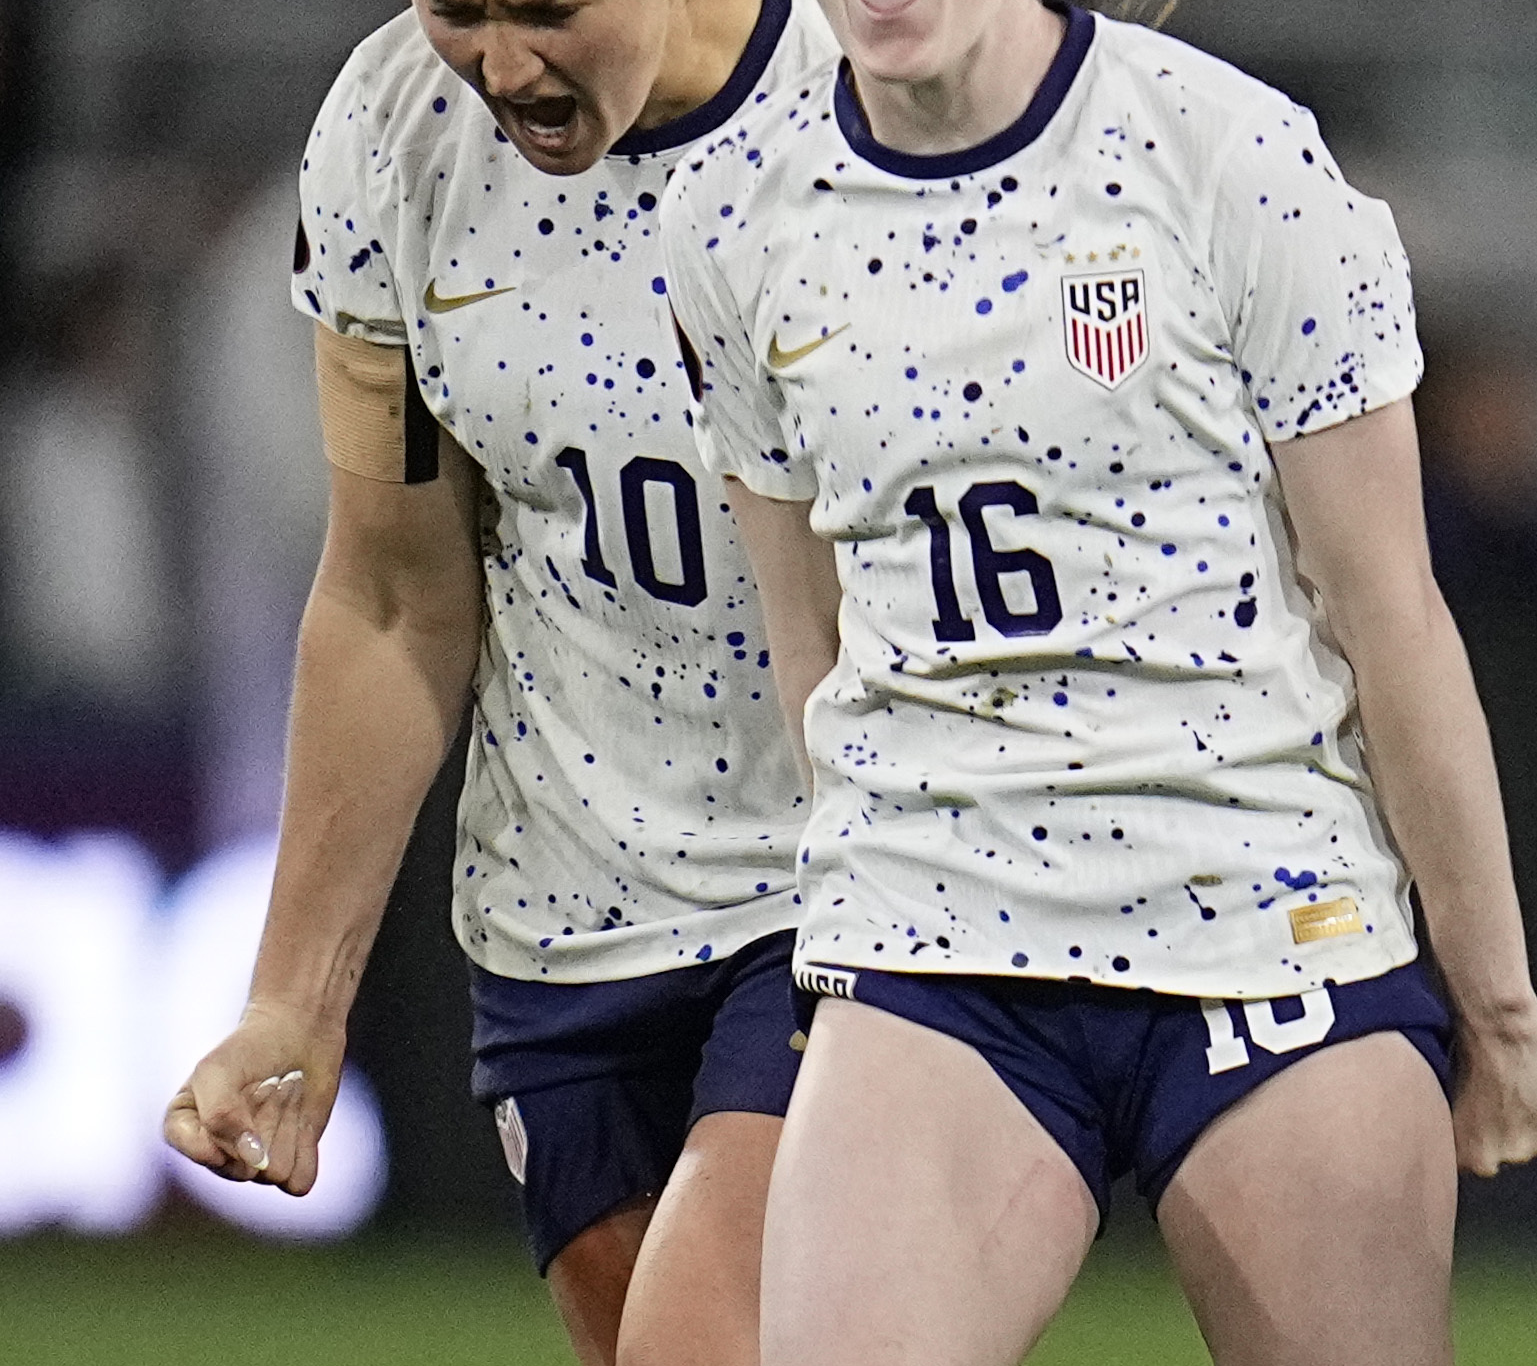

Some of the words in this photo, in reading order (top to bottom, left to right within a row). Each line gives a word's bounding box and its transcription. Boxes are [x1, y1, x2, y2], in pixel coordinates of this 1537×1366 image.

[1069, 279, 1140, 323] USA
[555, 446, 708, 607] 10
[903, 479, 1064, 643] 16
